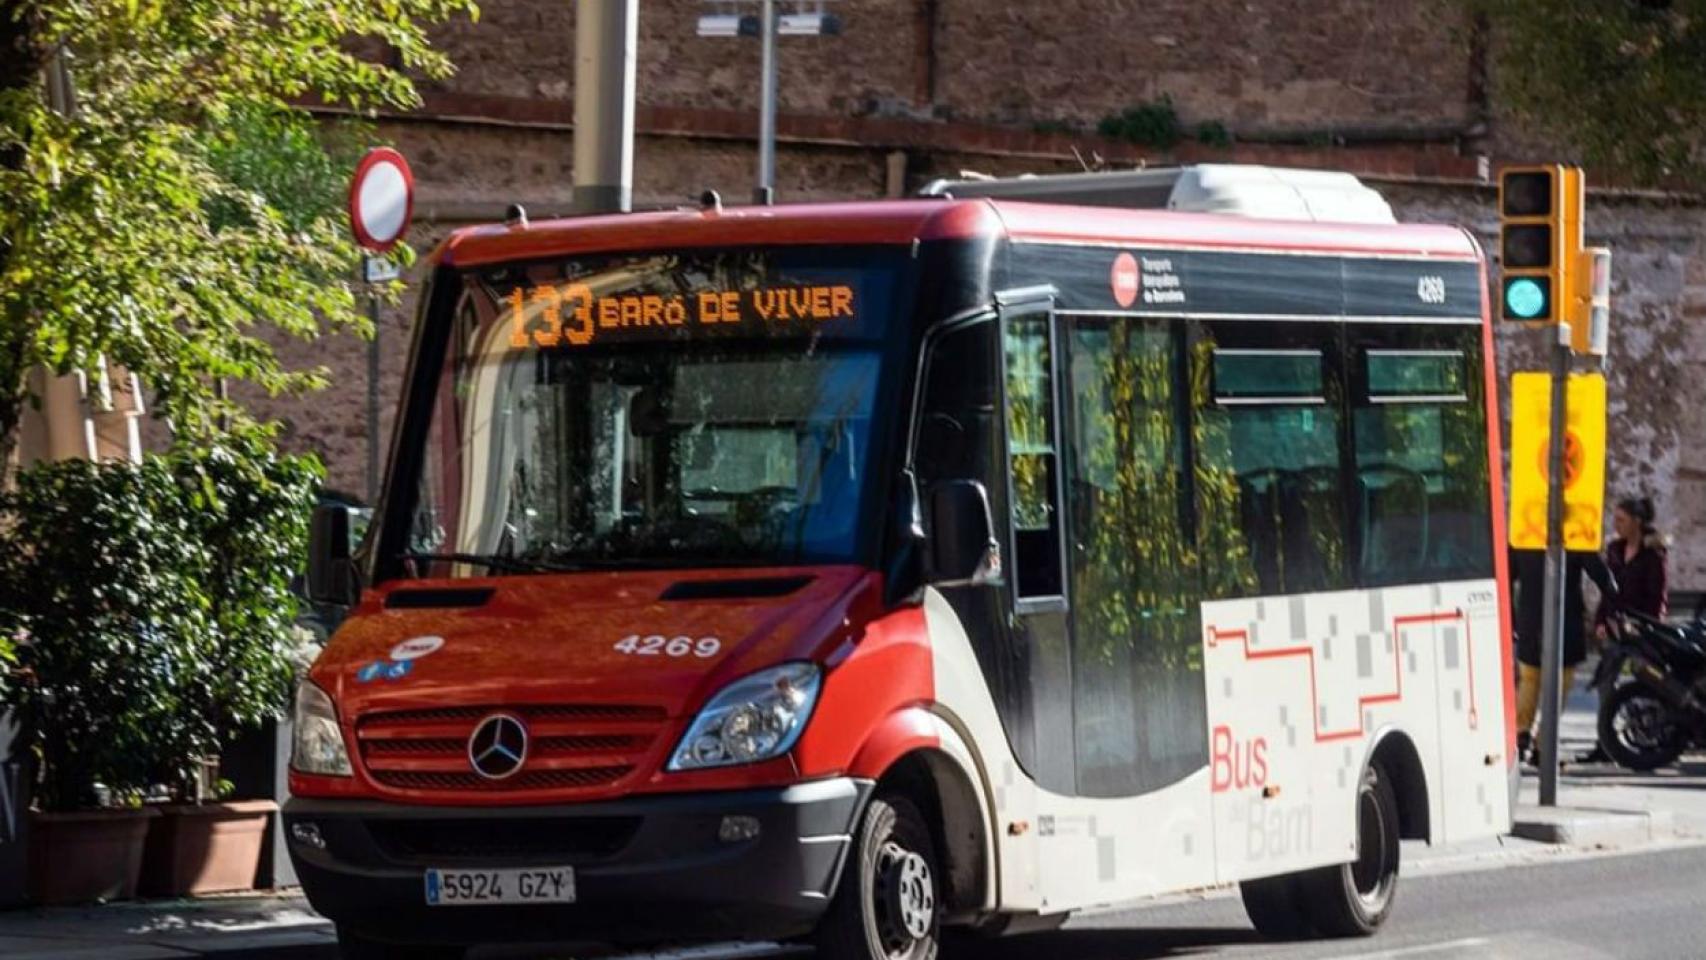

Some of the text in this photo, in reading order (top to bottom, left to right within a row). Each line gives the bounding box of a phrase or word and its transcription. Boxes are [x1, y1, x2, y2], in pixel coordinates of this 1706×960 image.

[1418, 276, 1444, 303] 4269
[507, 285, 594, 347] 133
[699, 291, 740, 322] DE
[753, 286, 853, 318] VIVER
[613, 635, 720, 657] 4269
[1211, 725, 1267, 793] Bus
[444, 873, 502, 899] 5924
[519, 872, 563, 898] GZY
